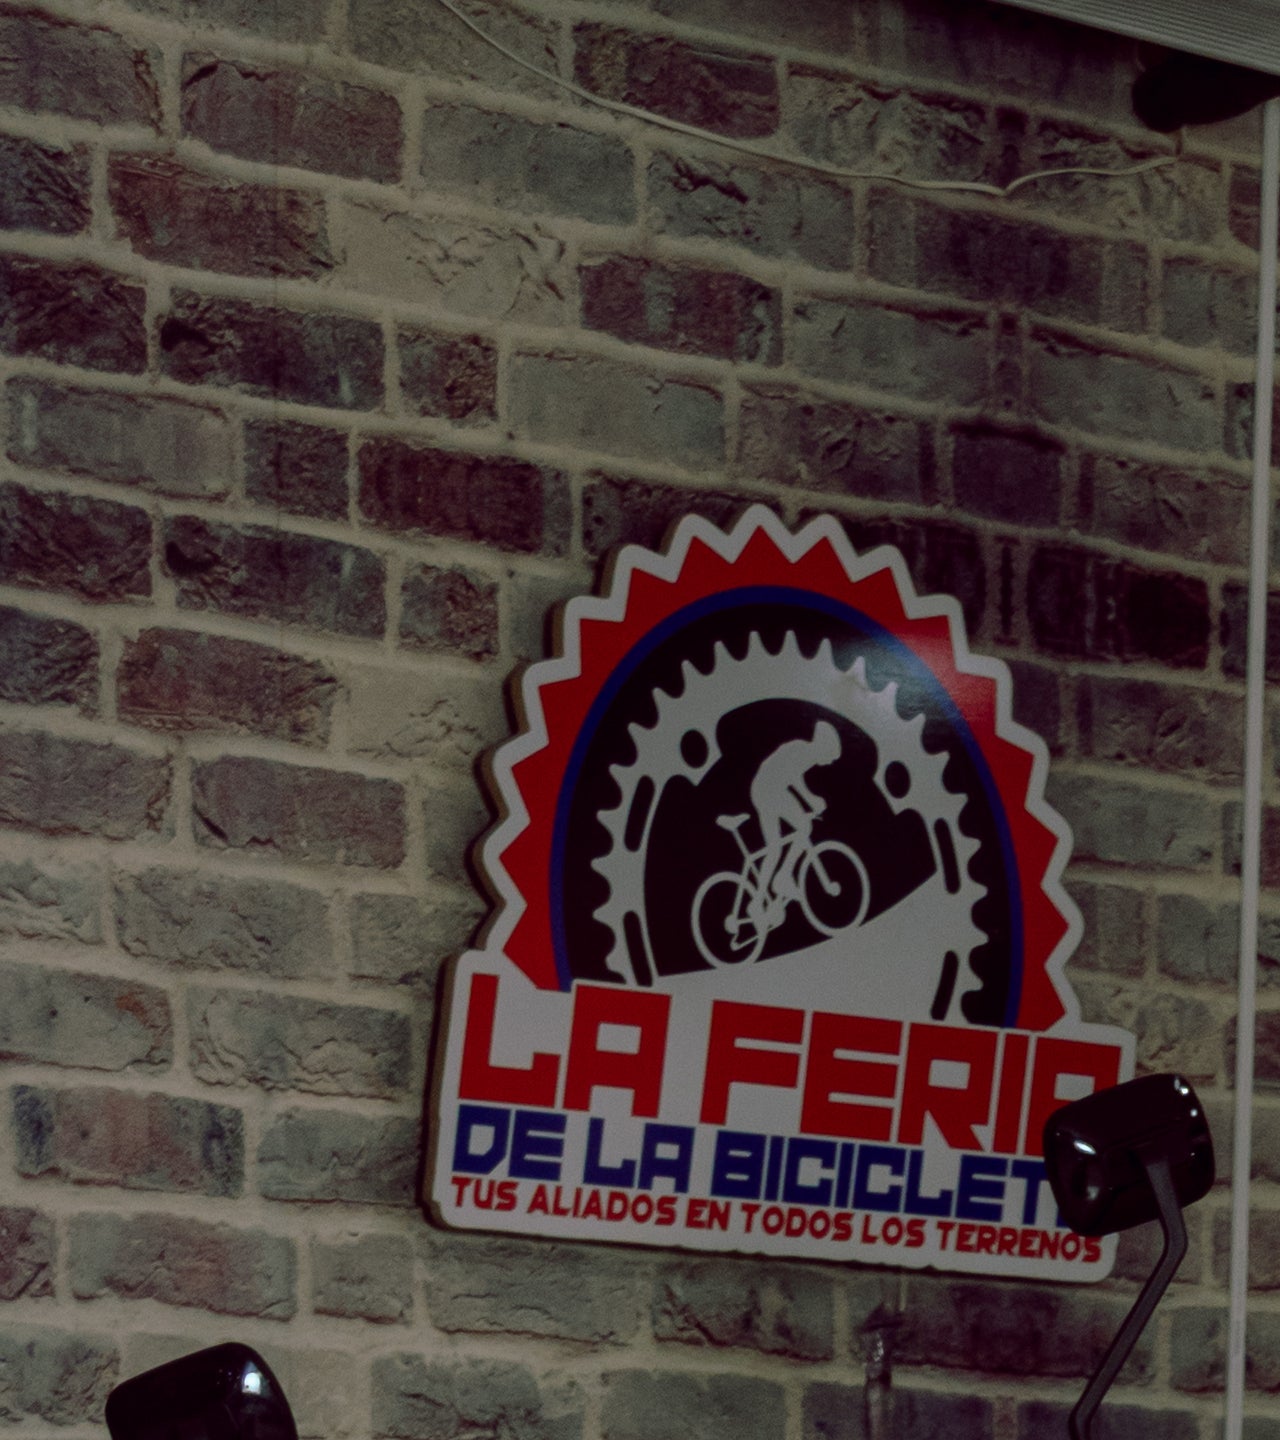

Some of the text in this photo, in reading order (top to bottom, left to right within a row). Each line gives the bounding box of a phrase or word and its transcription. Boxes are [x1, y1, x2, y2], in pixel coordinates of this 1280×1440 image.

[458, 974, 671, 1119] LA
[452, 1177, 1102, 1263] TUS ALIADOS EN TODOS LOS TERRENOS
[453, 1106, 1072, 1229] DE LA BICICLET
